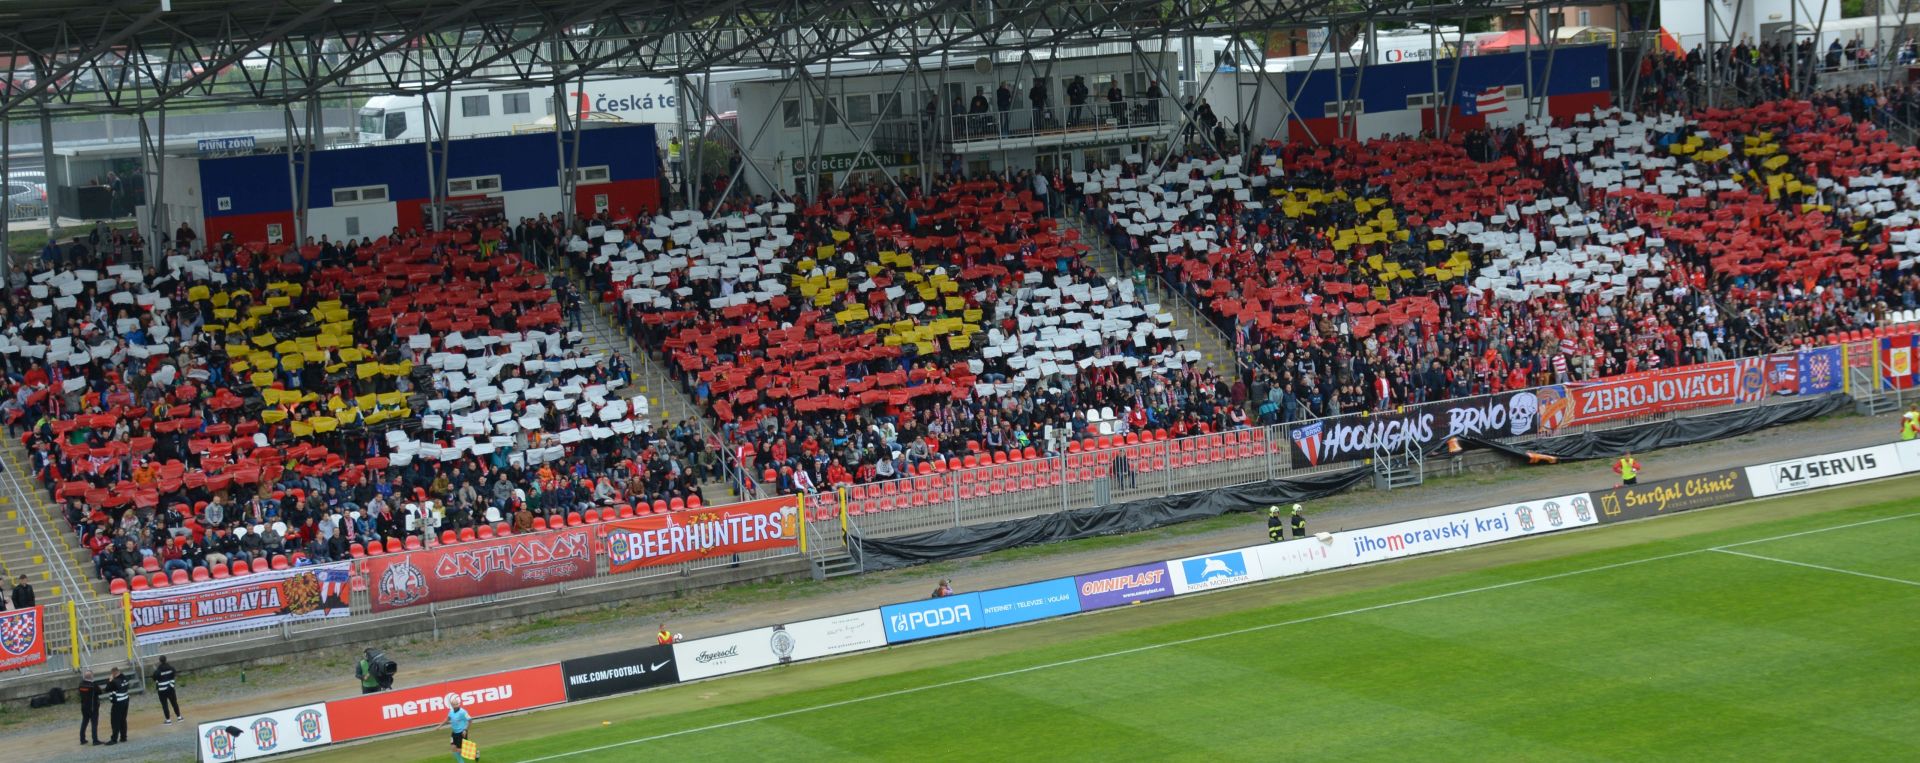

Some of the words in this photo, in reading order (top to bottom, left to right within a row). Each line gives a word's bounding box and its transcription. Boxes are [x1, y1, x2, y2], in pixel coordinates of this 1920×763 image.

[596, 93, 653, 112] Česká
[1323, 411, 1434, 461] HOOLIGANS
[1443, 396, 1507, 440] BRNO
[1779, 464, 1806, 483] AZ
[1807, 453, 1876, 478] SERVIS
[628, 511, 783, 560] BEERHUNTERS
[1353, 519, 1469, 557] jihomoravský
[1476, 512, 1510, 533] kraj
[435, 532, 591, 581] ORTHODOX
[1082, 569, 1164, 596] OMNIPLAST
[131, 601, 191, 628] SOUTH
[910, 604, 971, 630] PODA
[984, 604, 1013, 614] INTERNET
[695, 644, 739, 664] Ingersoll
[570, 663, 646, 686] NIKE.COM/FOOTBALL
